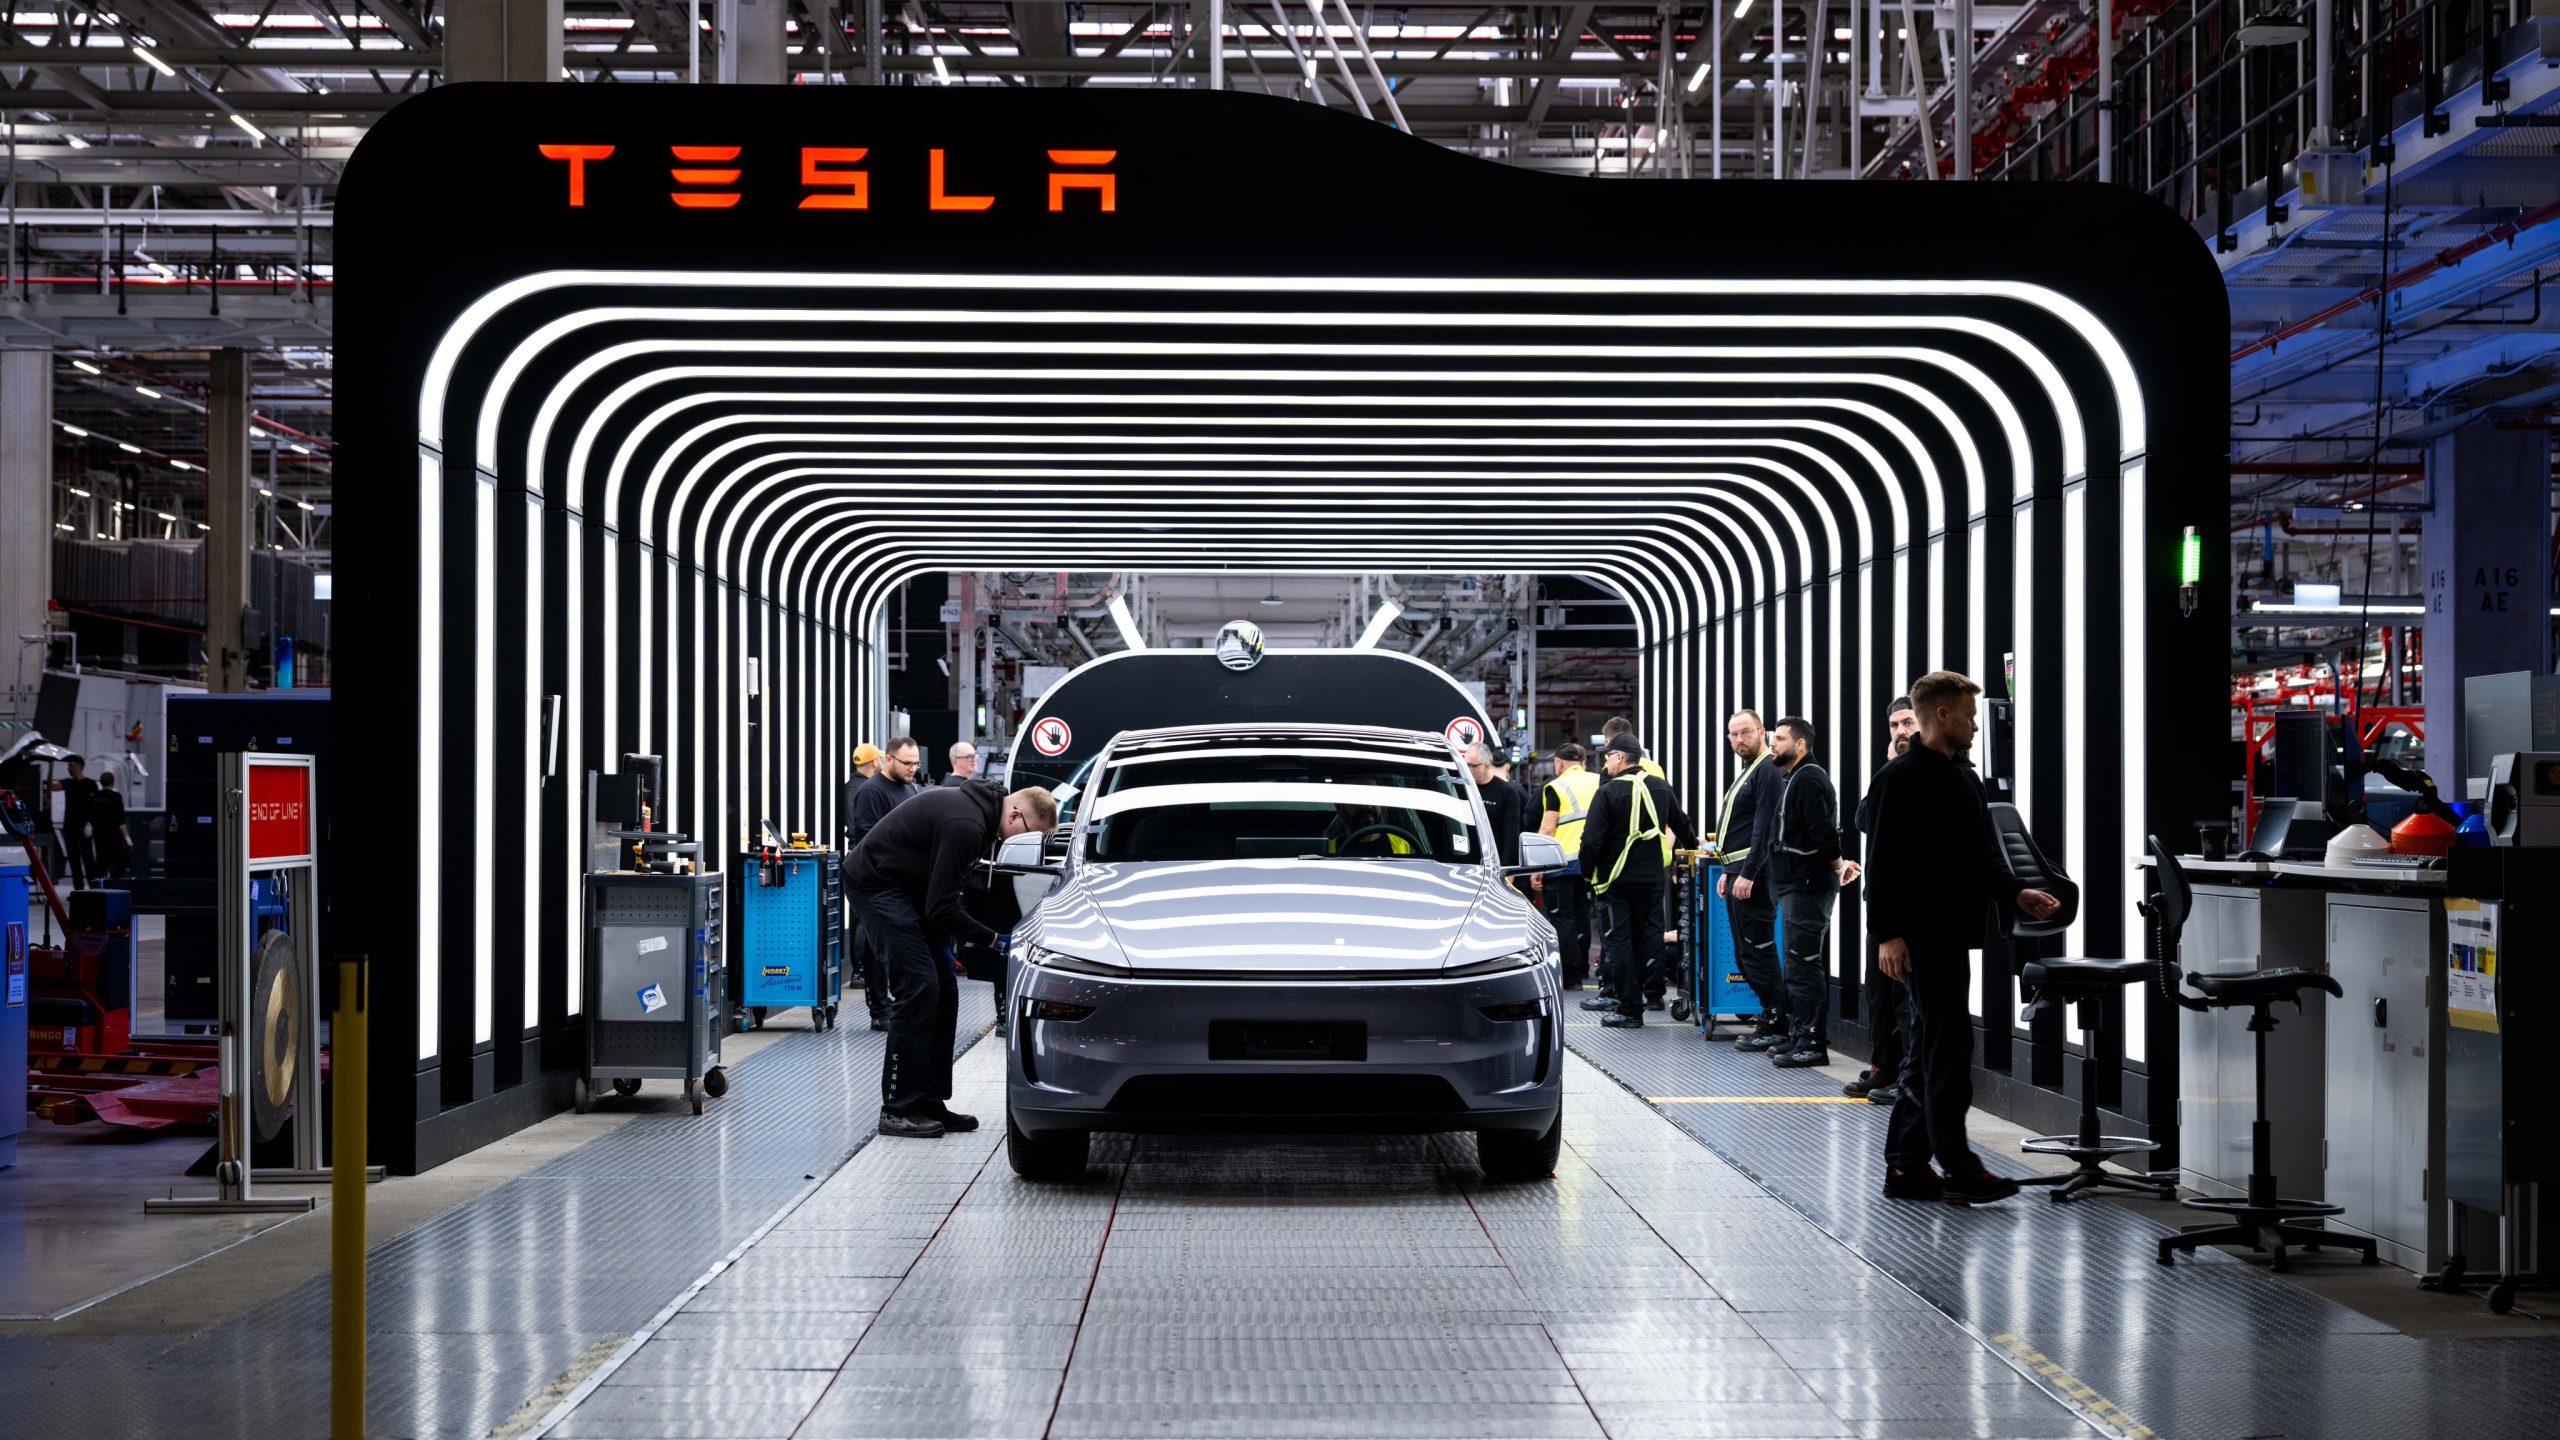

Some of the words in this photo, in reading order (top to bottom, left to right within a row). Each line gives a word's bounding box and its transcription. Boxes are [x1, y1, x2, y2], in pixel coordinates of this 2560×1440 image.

[538, 144, 1117, 212] TESLA
[2431, 569, 2445, 590] A16
[2474, 567, 2518, 586] A16
[2433, 594, 2442, 615] AE
[2481, 592, 2508, 611] AE
[251, 803, 268, 820] END
[269, 803, 280, 820] OF
